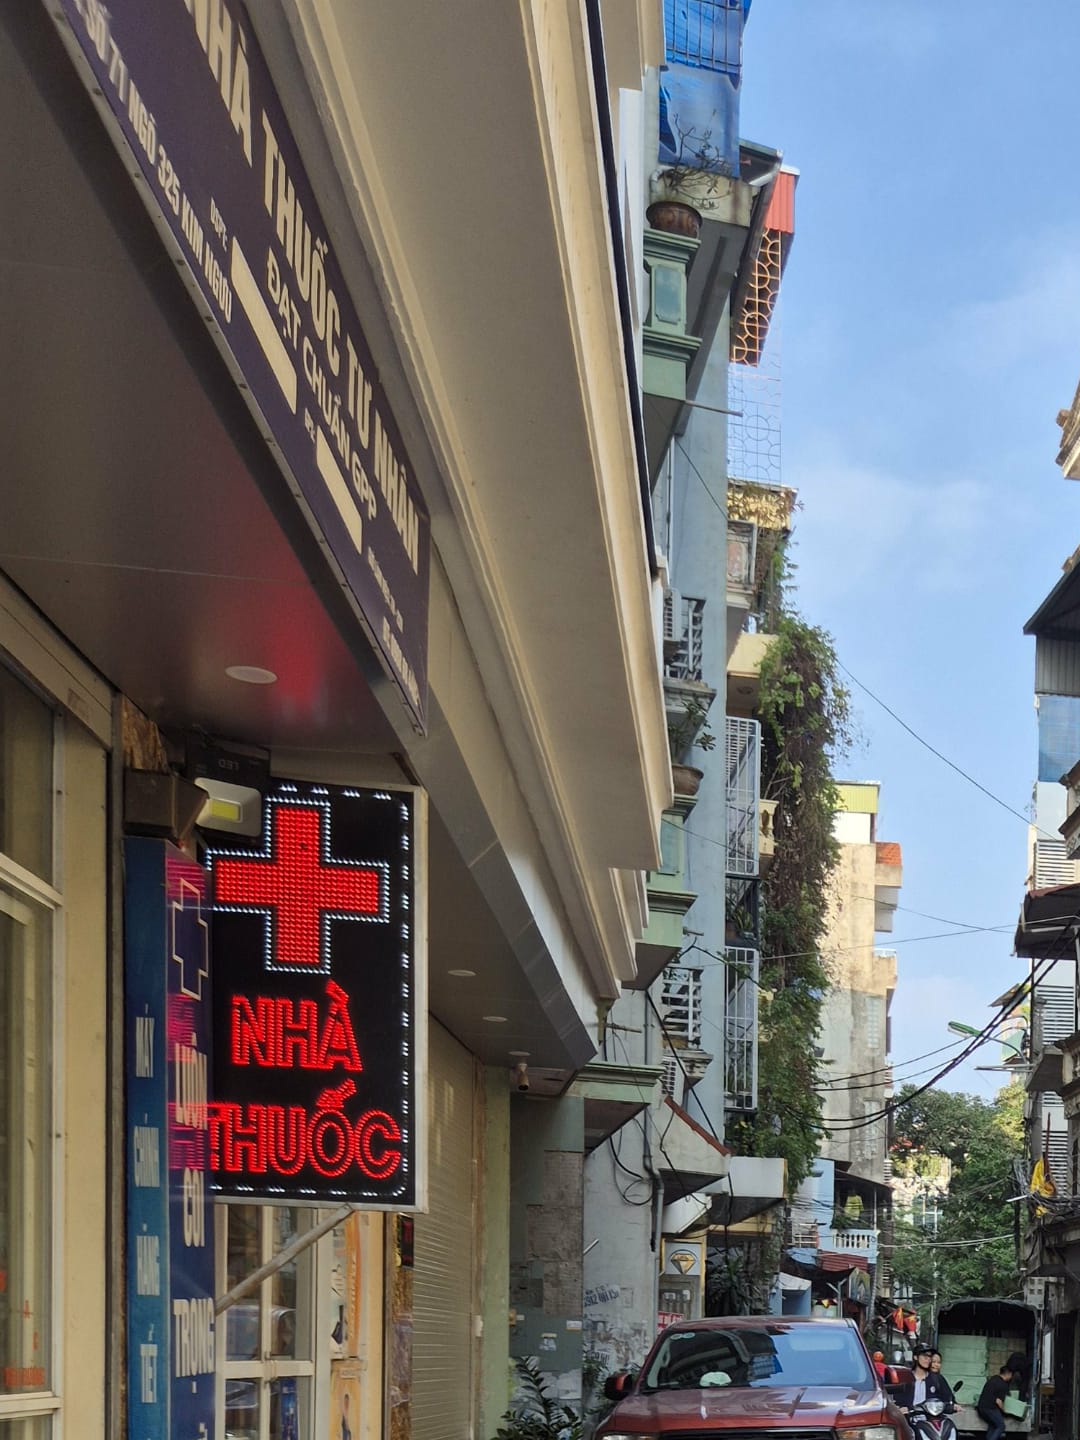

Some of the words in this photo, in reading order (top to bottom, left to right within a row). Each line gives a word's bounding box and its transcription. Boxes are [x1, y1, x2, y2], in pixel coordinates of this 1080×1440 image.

[109, 36, 125, 101] 71
[158, 144, 180, 215] 325
[181, 193, 203, 265] KIM
[262, 108, 341, 377] THUỐC
[347, 333, 373, 449] TƯ
[374, 408, 419, 576] NHÂN
[267, 247, 301, 351] ĐẠT
[303, 336, 350, 471] CHUẨN
[352, 451, 377, 520] GPP
[136, 1003, 155, 1078] MÁY
[231, 978, 363, 1071] NHÀ
[175, 1032, 208, 1131] LUÔN
[207, 1078, 401, 1179] THUỐC
[184, 1166, 205, 1247] COI
[173, 1297, 216, 1393] TRỌNG
